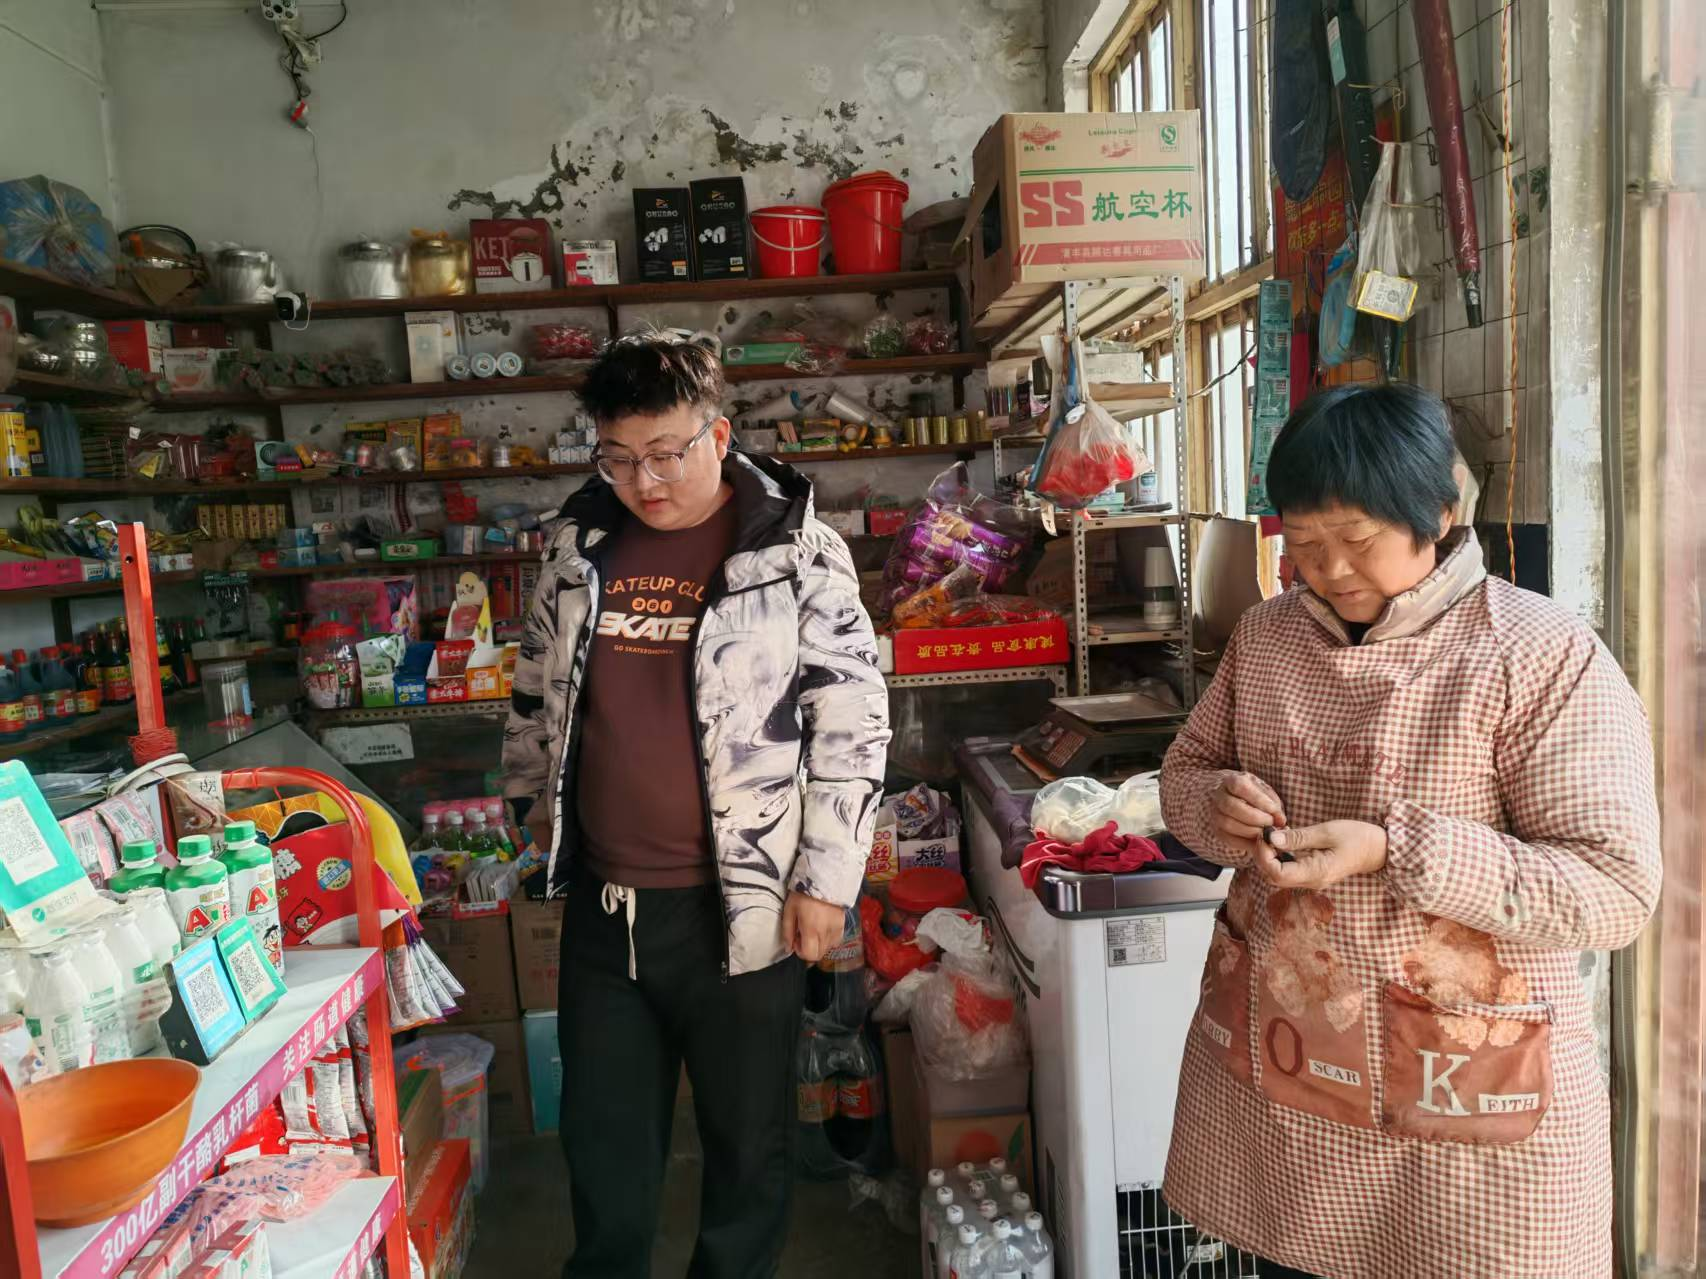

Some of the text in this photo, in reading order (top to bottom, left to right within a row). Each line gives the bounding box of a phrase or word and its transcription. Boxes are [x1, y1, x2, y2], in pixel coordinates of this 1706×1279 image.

[1020, 180, 1085, 228] SS
[1091, 188, 1193, 222] 航空杯
[596, 611, 697, 641] SKATE
[916, 634, 1055, 658] 健康食品 贵在品质
[1265, 1016, 1358, 1083] O SCAR
[1415, 1048, 1536, 1116] K EITH
[100, 1080, 260, 1275] 300亿副干酪乳杆菌
[282, 972, 366, 1081] 关注肠道健康
